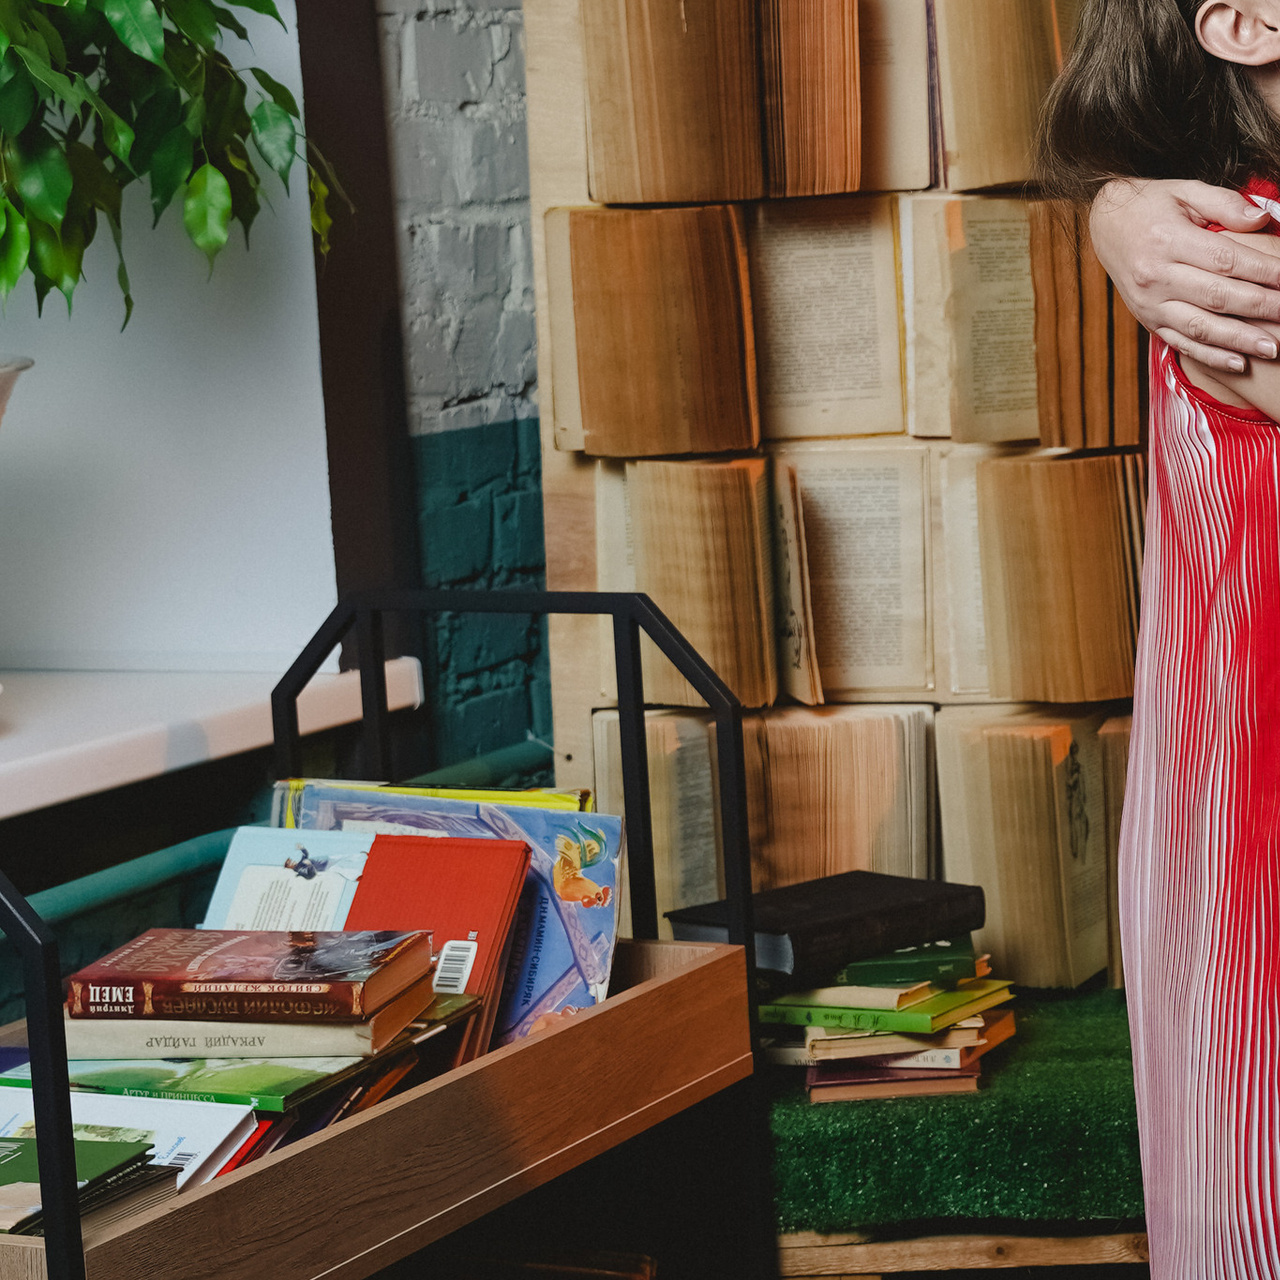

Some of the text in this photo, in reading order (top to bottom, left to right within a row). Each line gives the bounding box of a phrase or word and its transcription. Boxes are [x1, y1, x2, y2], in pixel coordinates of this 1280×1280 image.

[88, 983, 135, 1003] ЕМЕЦ
[192, 983, 323, 993] СВИТОК ЖЕЛАНИЙ
[89, 1004, 135, 1014] Дмитрий
[160, 996, 240, 1016] БУСЛАЕВ
[145, 1035, 266, 1049] АРКАДИЙ ГАЙДАР
